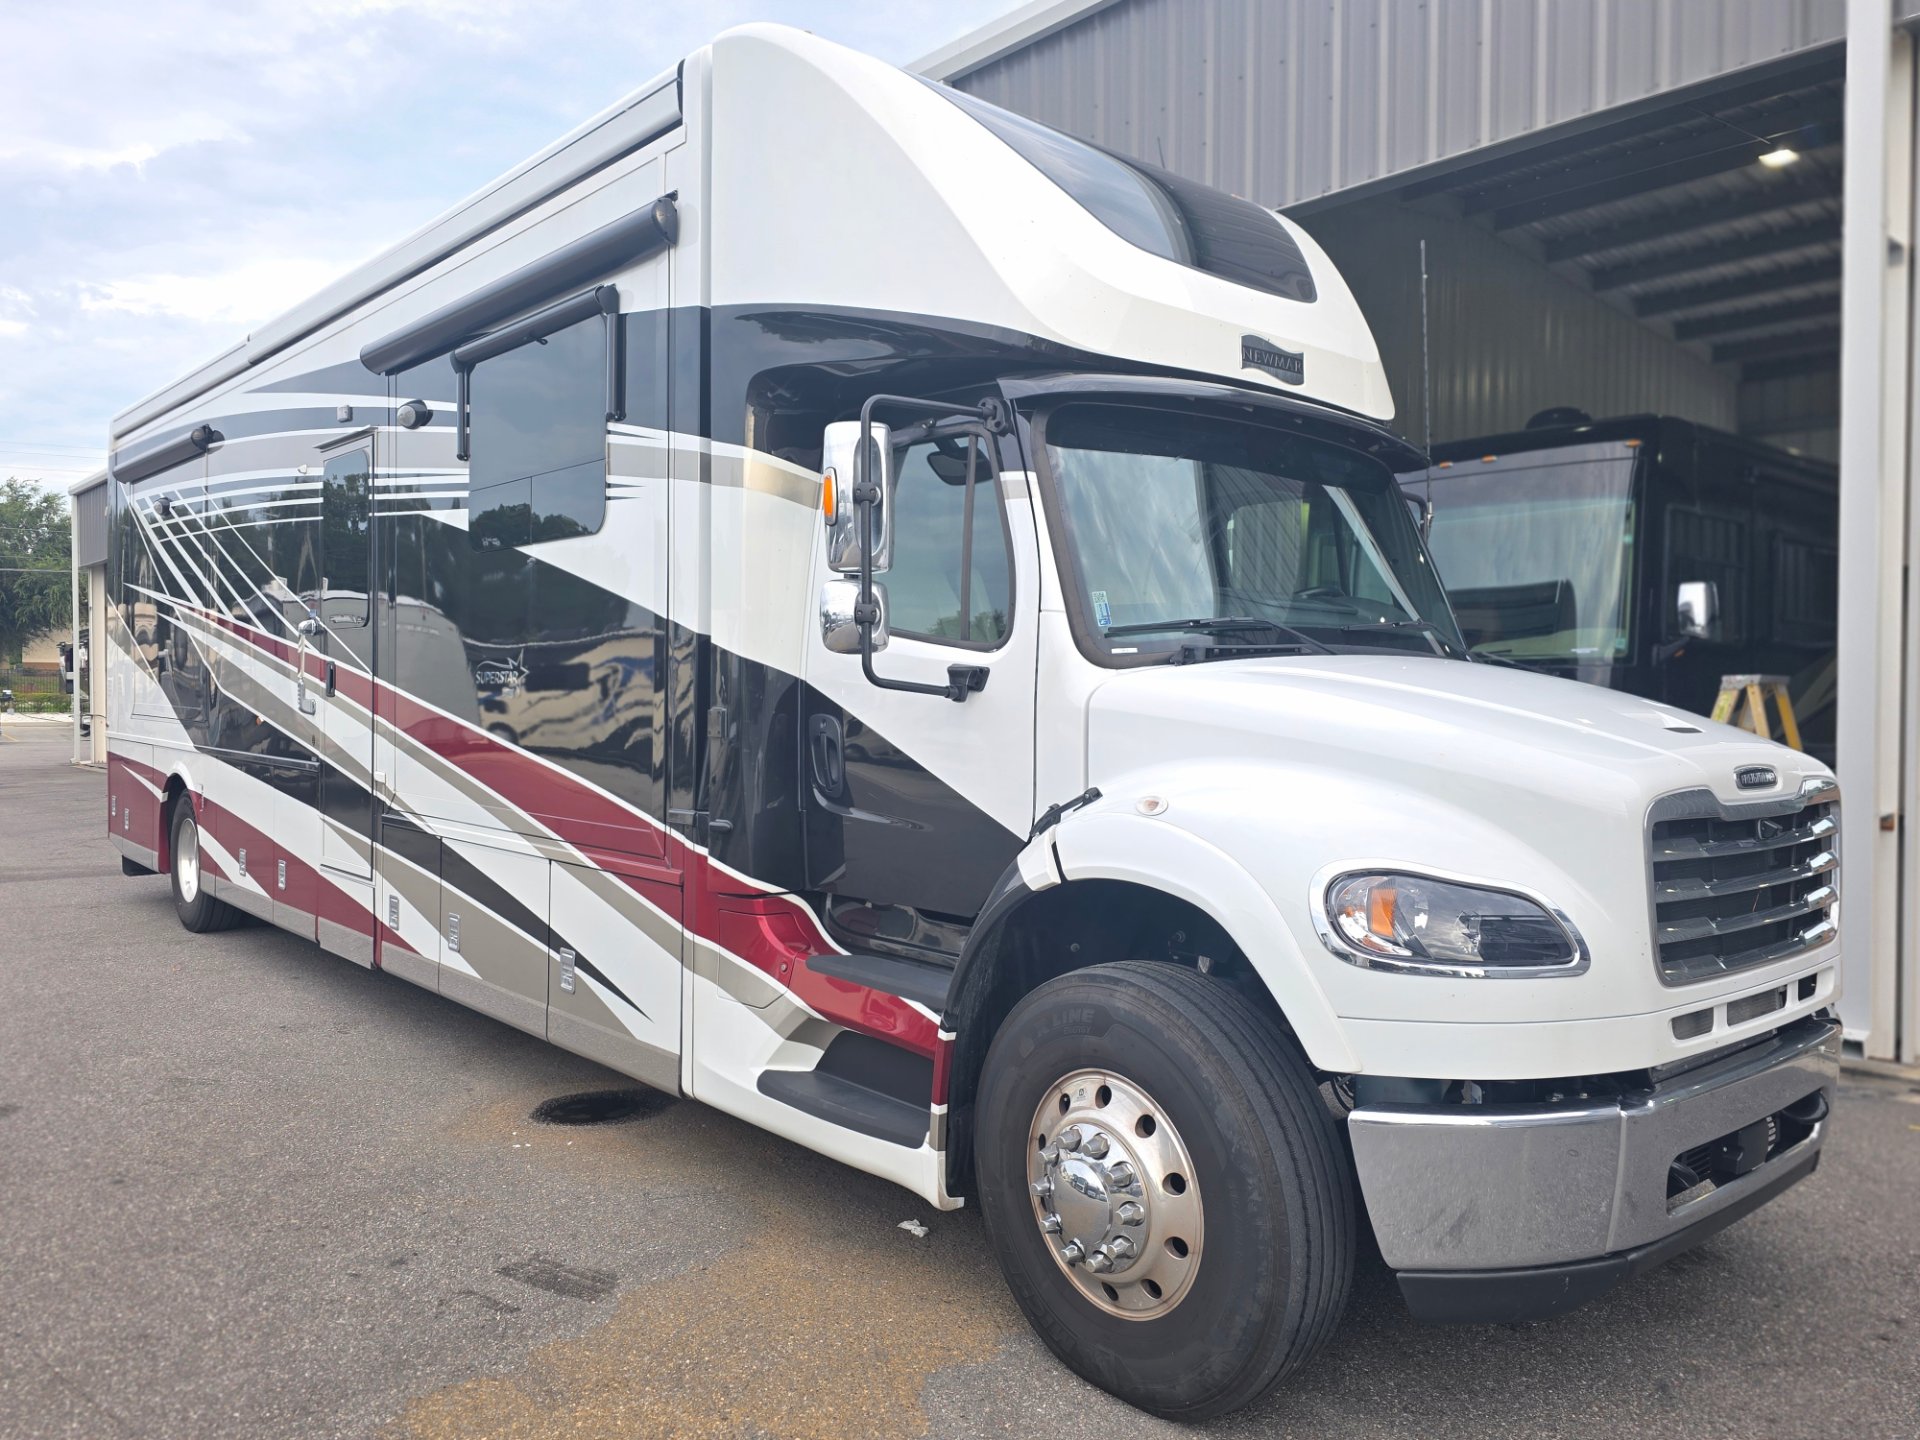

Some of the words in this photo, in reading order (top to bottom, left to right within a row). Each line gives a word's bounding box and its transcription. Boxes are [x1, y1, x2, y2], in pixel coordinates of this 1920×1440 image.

[1242, 346, 1303, 372] NEWMAR
[475, 671, 519, 685] SUPERSTAR
[1052, 1008, 1096, 1026] LINE
